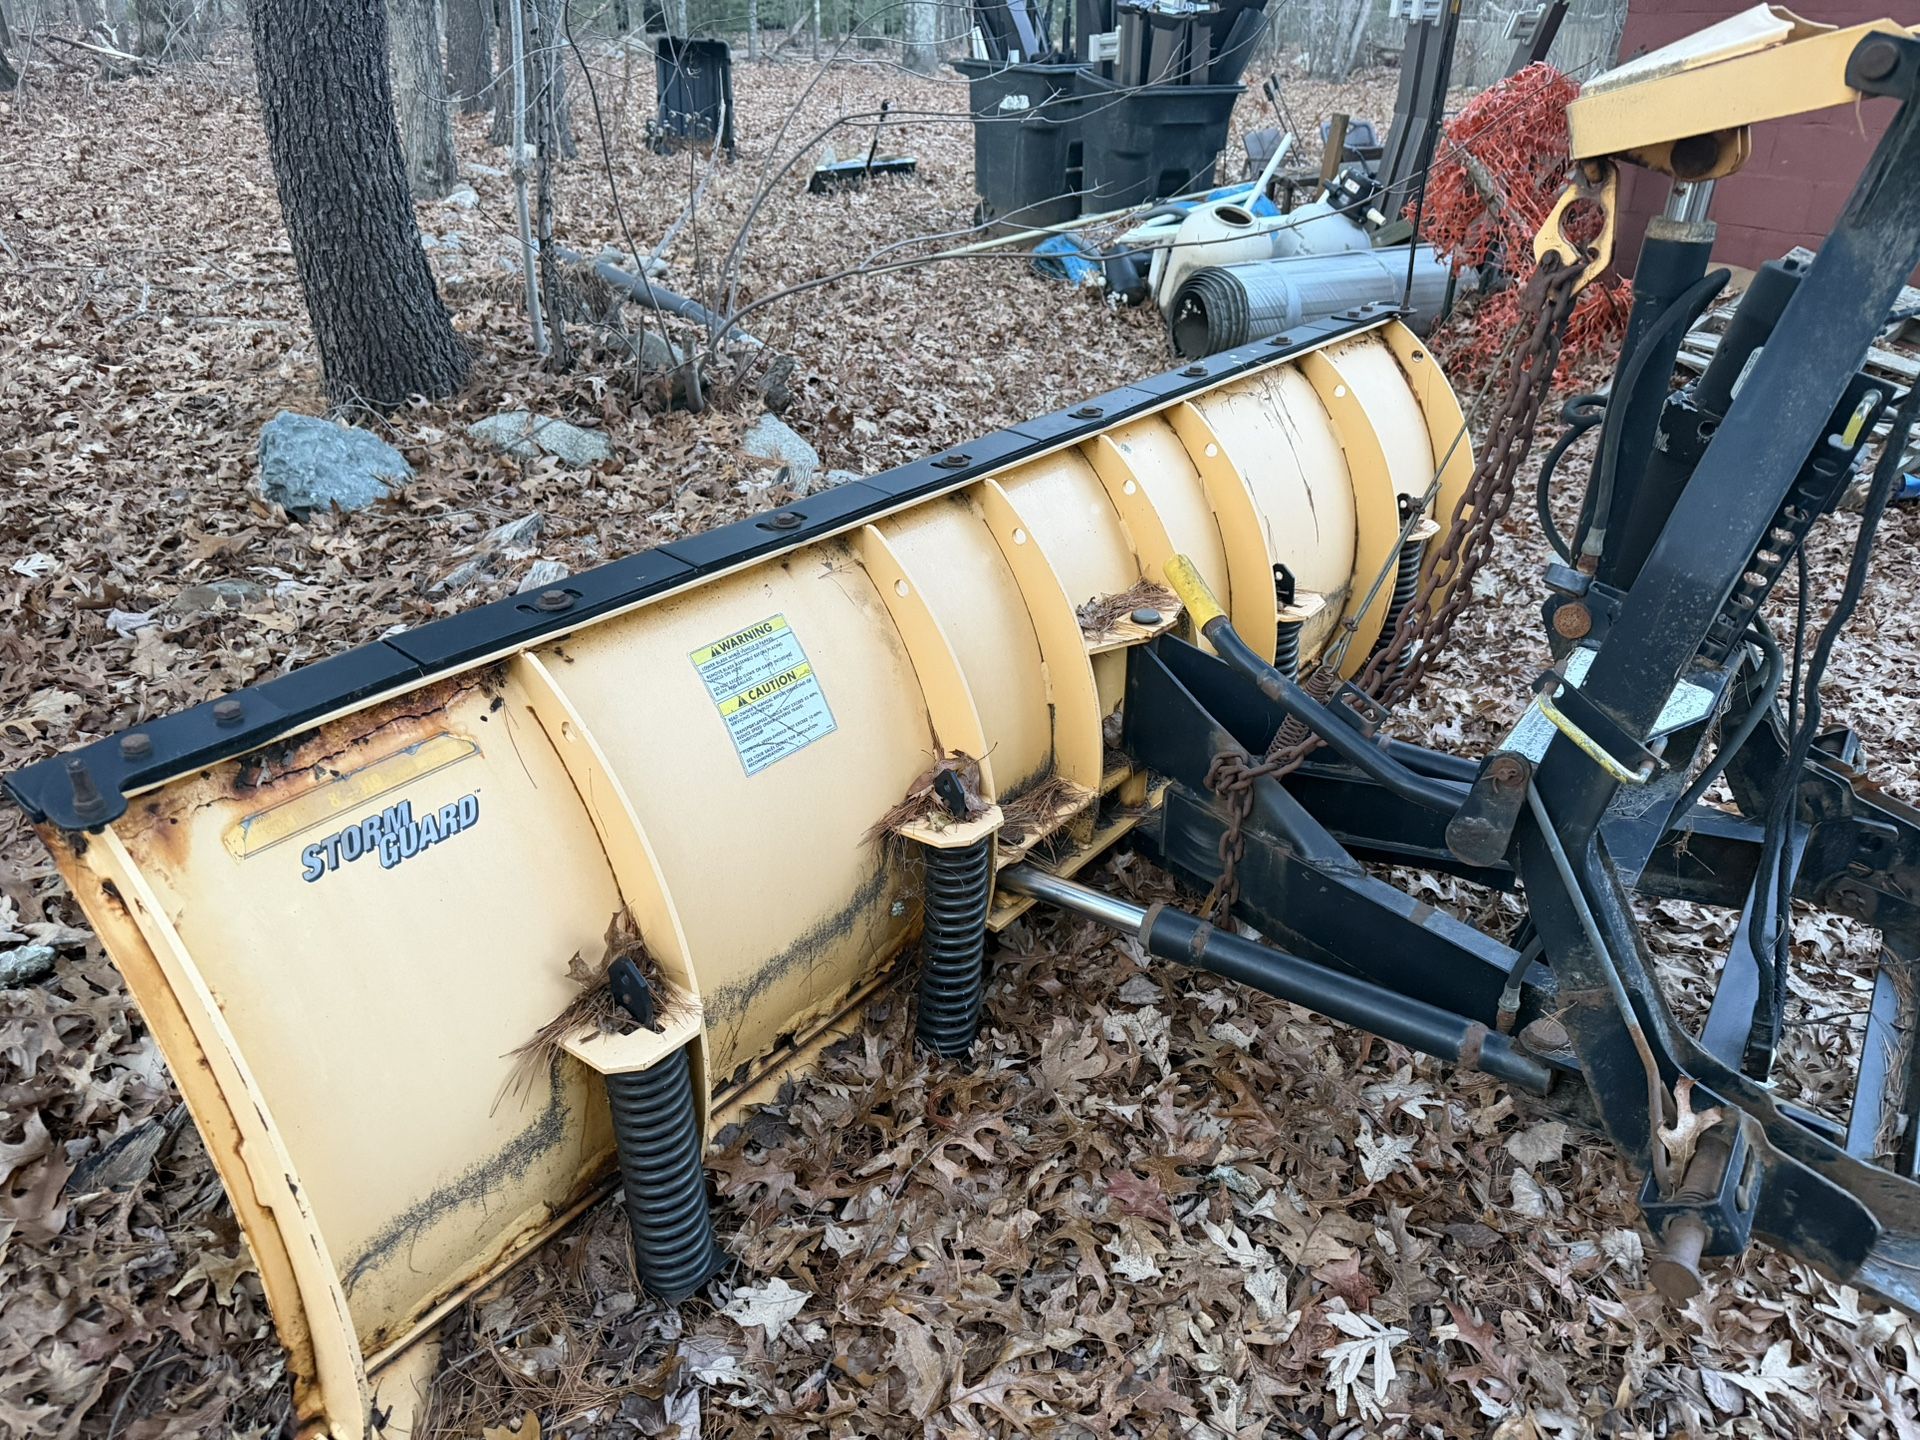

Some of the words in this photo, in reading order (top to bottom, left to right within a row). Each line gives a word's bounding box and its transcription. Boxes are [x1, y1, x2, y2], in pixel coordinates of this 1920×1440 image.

[717, 622, 773, 653] WARNING
[747, 670, 796, 701] CAUTION
[301, 799, 413, 883] STORM
[377, 793, 479, 869] GUARD
